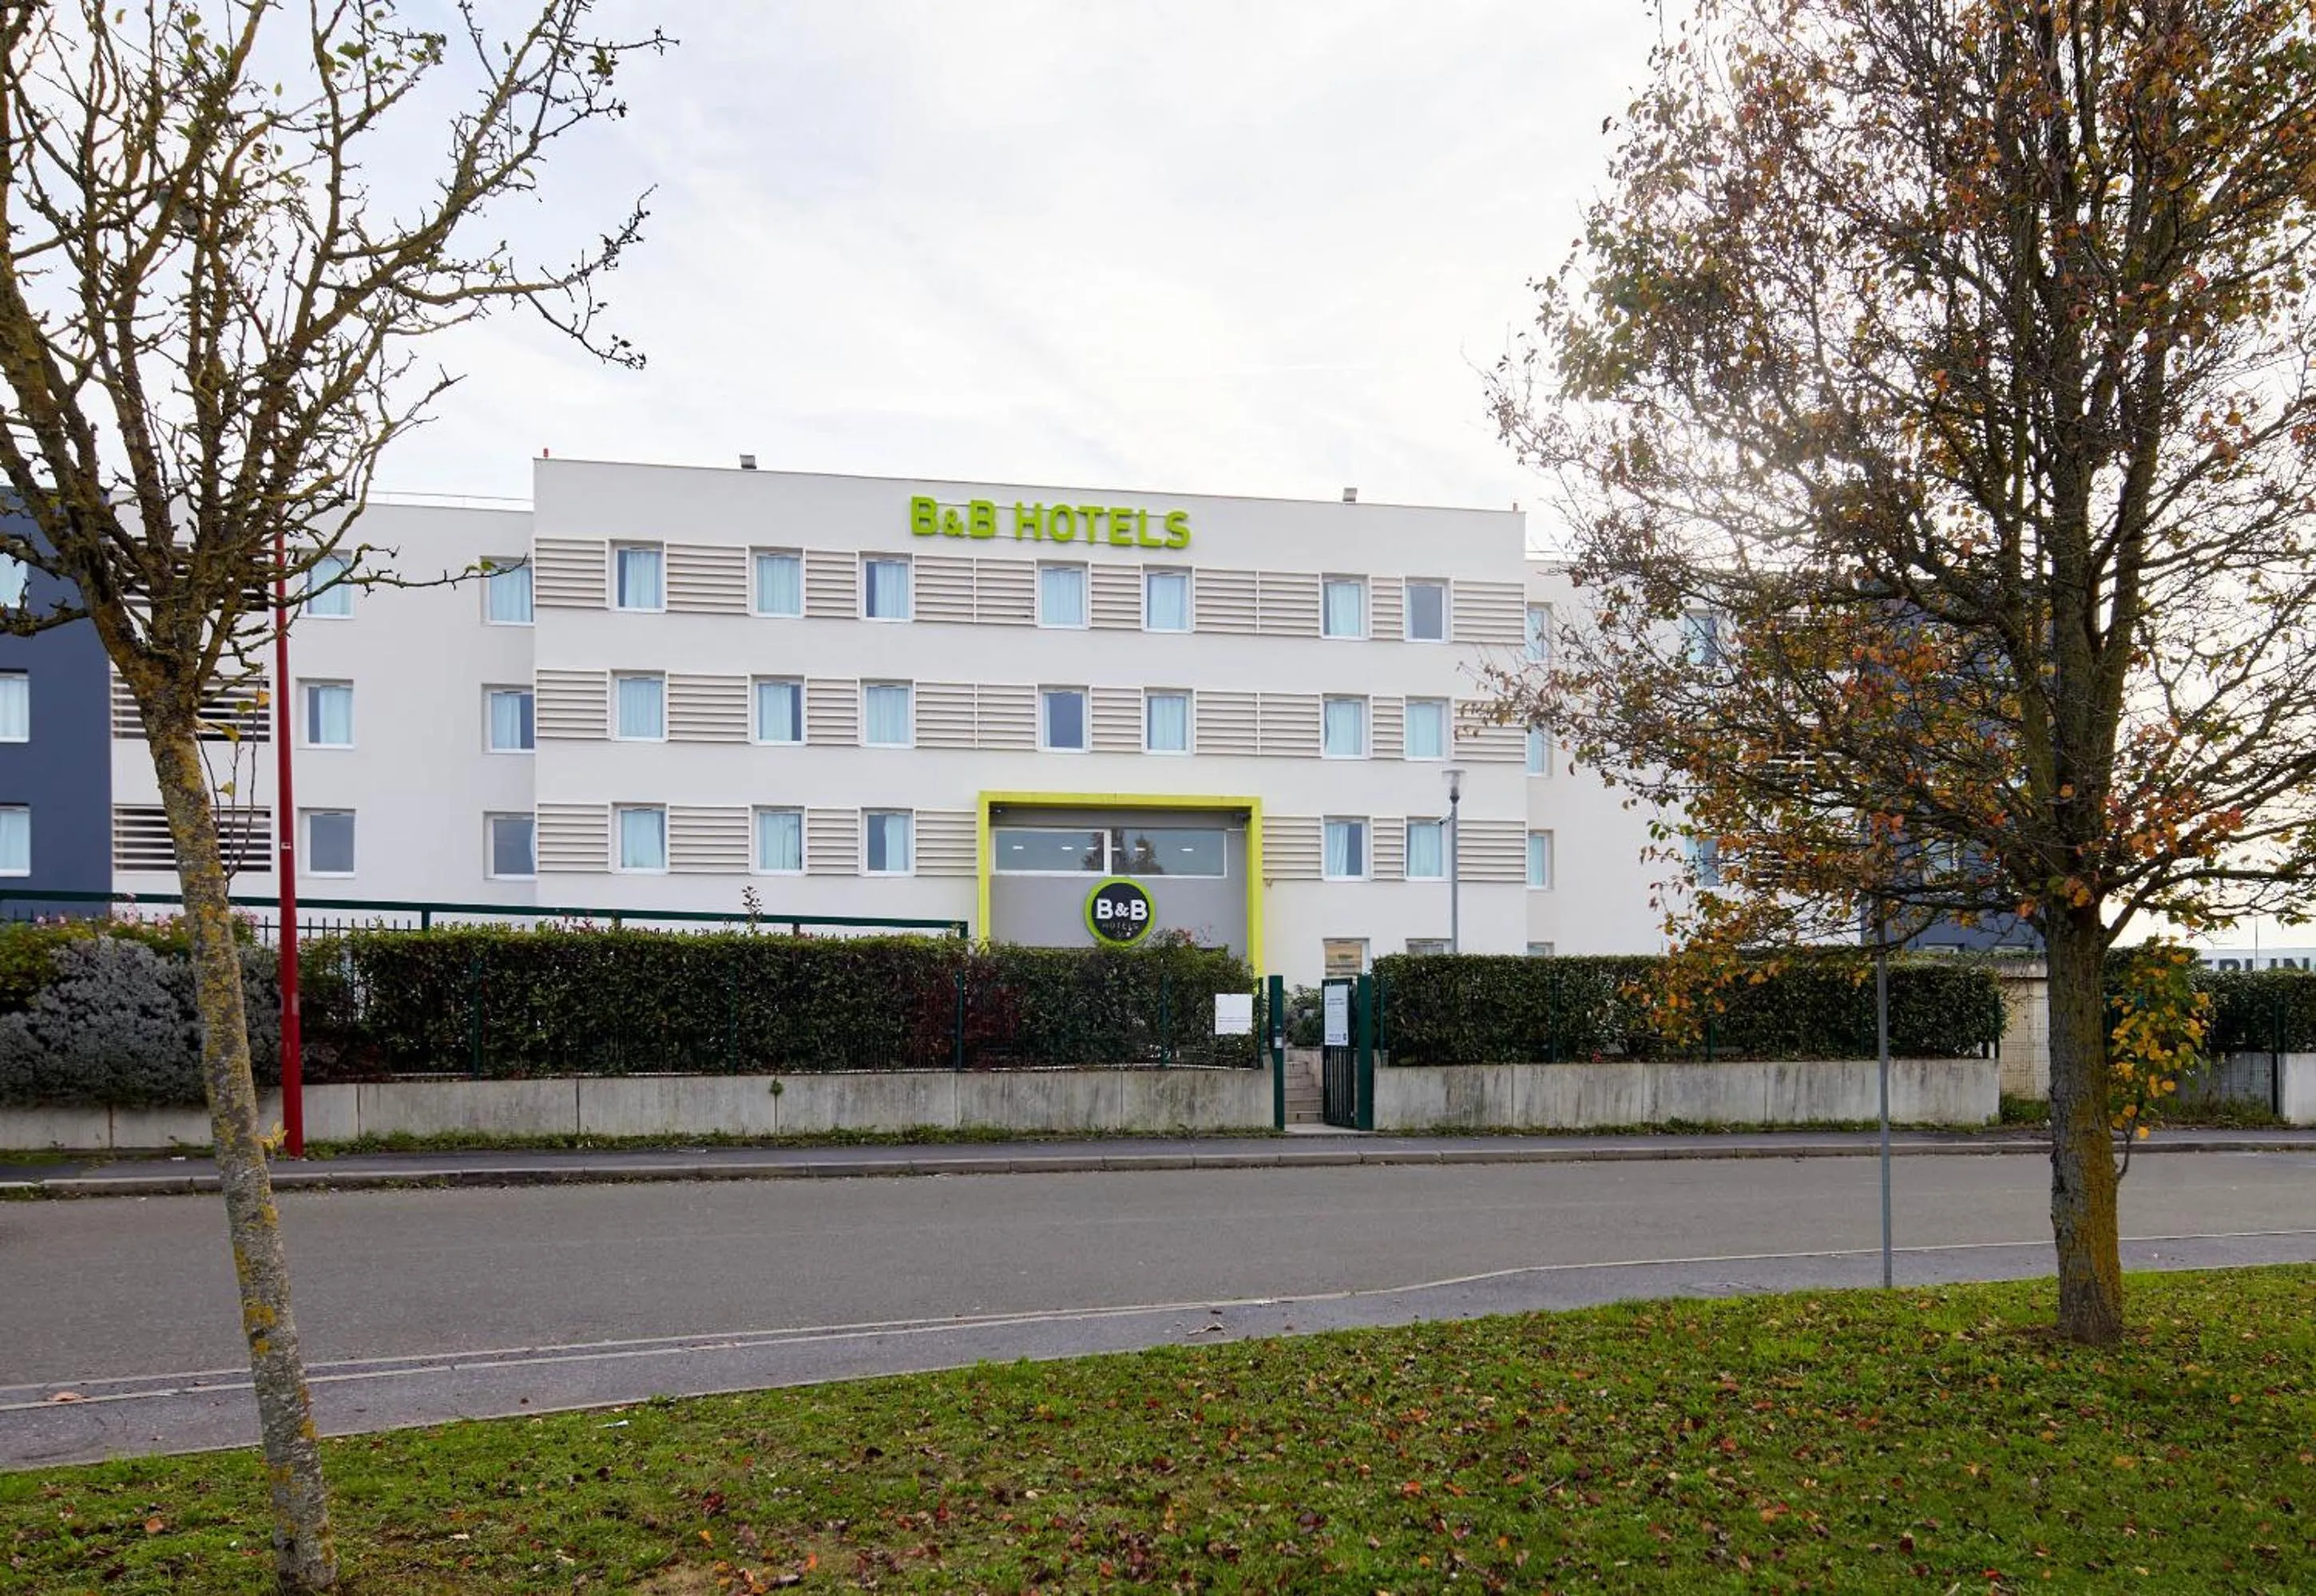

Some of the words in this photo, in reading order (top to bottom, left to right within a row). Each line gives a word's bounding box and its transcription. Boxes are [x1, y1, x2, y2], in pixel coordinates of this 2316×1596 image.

[910, 496, 997, 539] B&B
[1013, 501, 1191, 549] HOTELS
[1097, 898, 1148, 921] B&B
